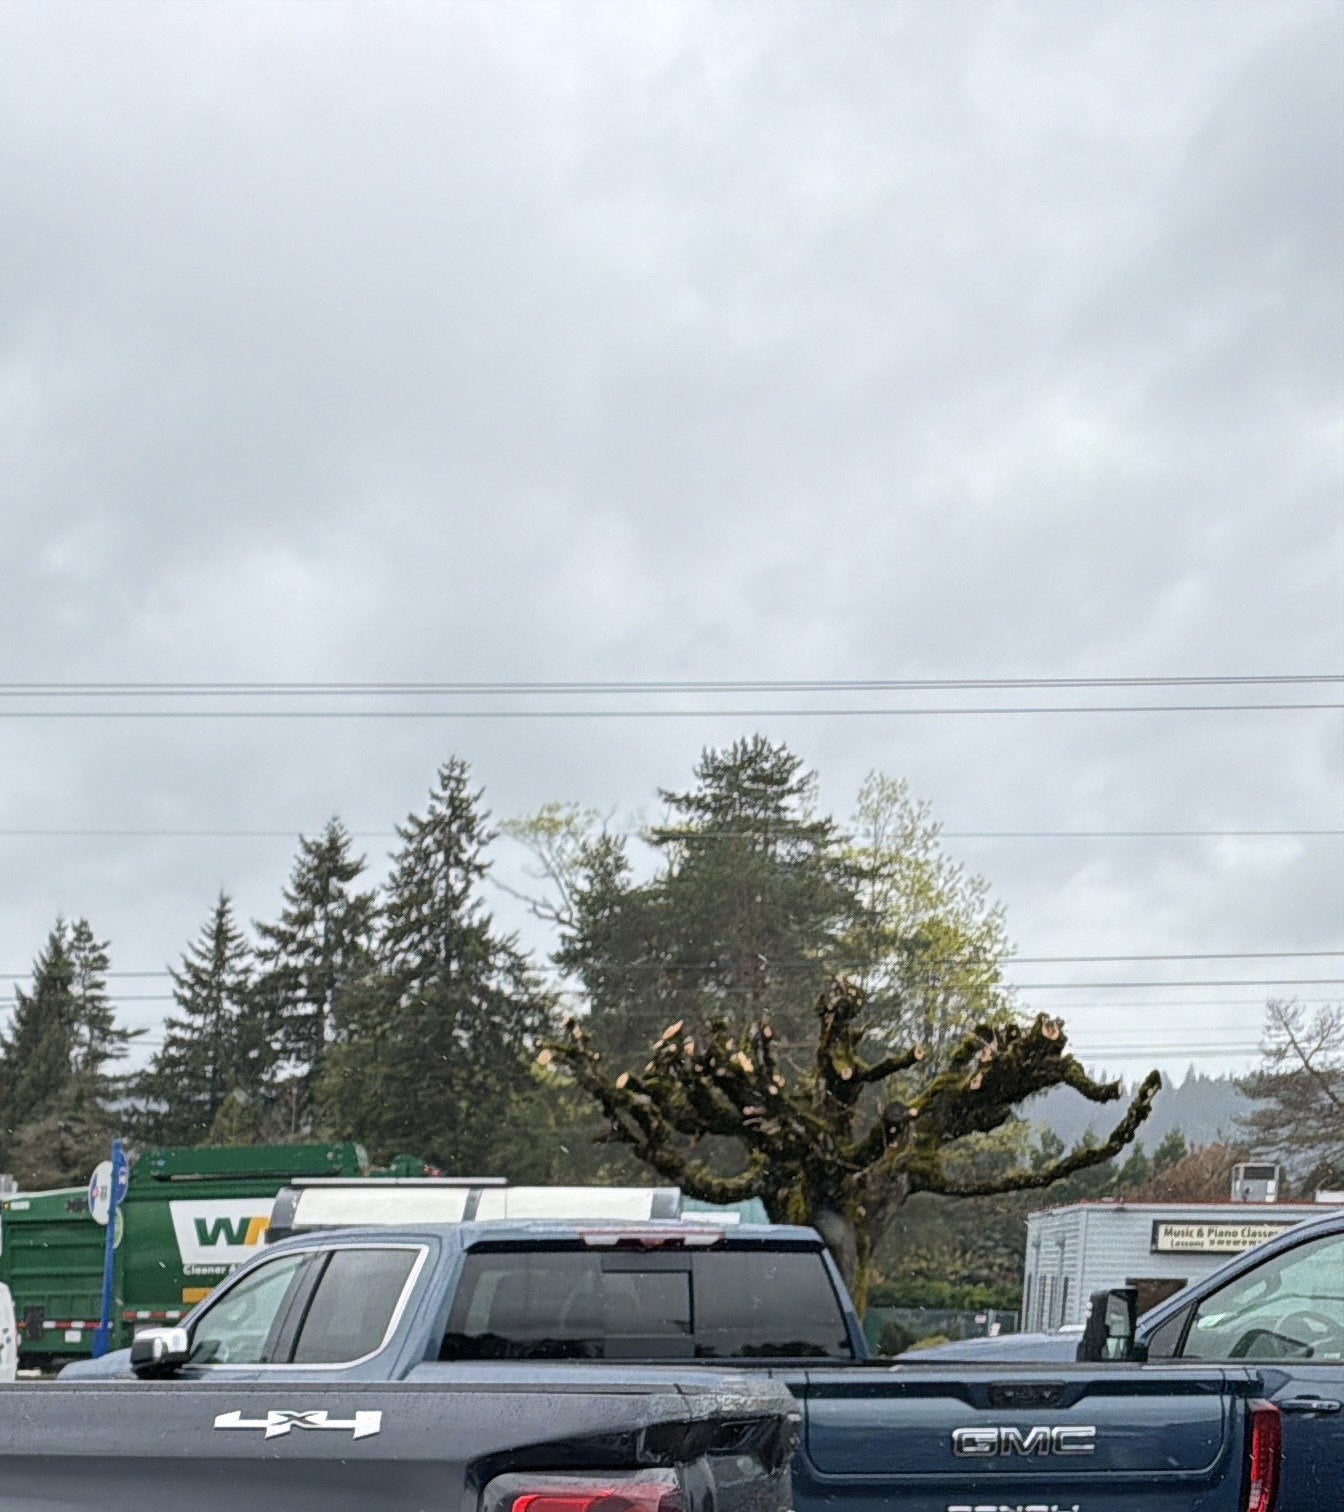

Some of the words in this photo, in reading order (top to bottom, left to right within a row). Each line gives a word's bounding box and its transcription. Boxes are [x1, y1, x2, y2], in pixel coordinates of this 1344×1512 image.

[1164, 1227, 1193, 1237] Music
[1197, 1227, 1204, 1237] &
[1207, 1227, 1238, 1237] Piano
[183, 1264, 227, 1276] Cleaner
[952, 1426, 1096, 1457] GMC
